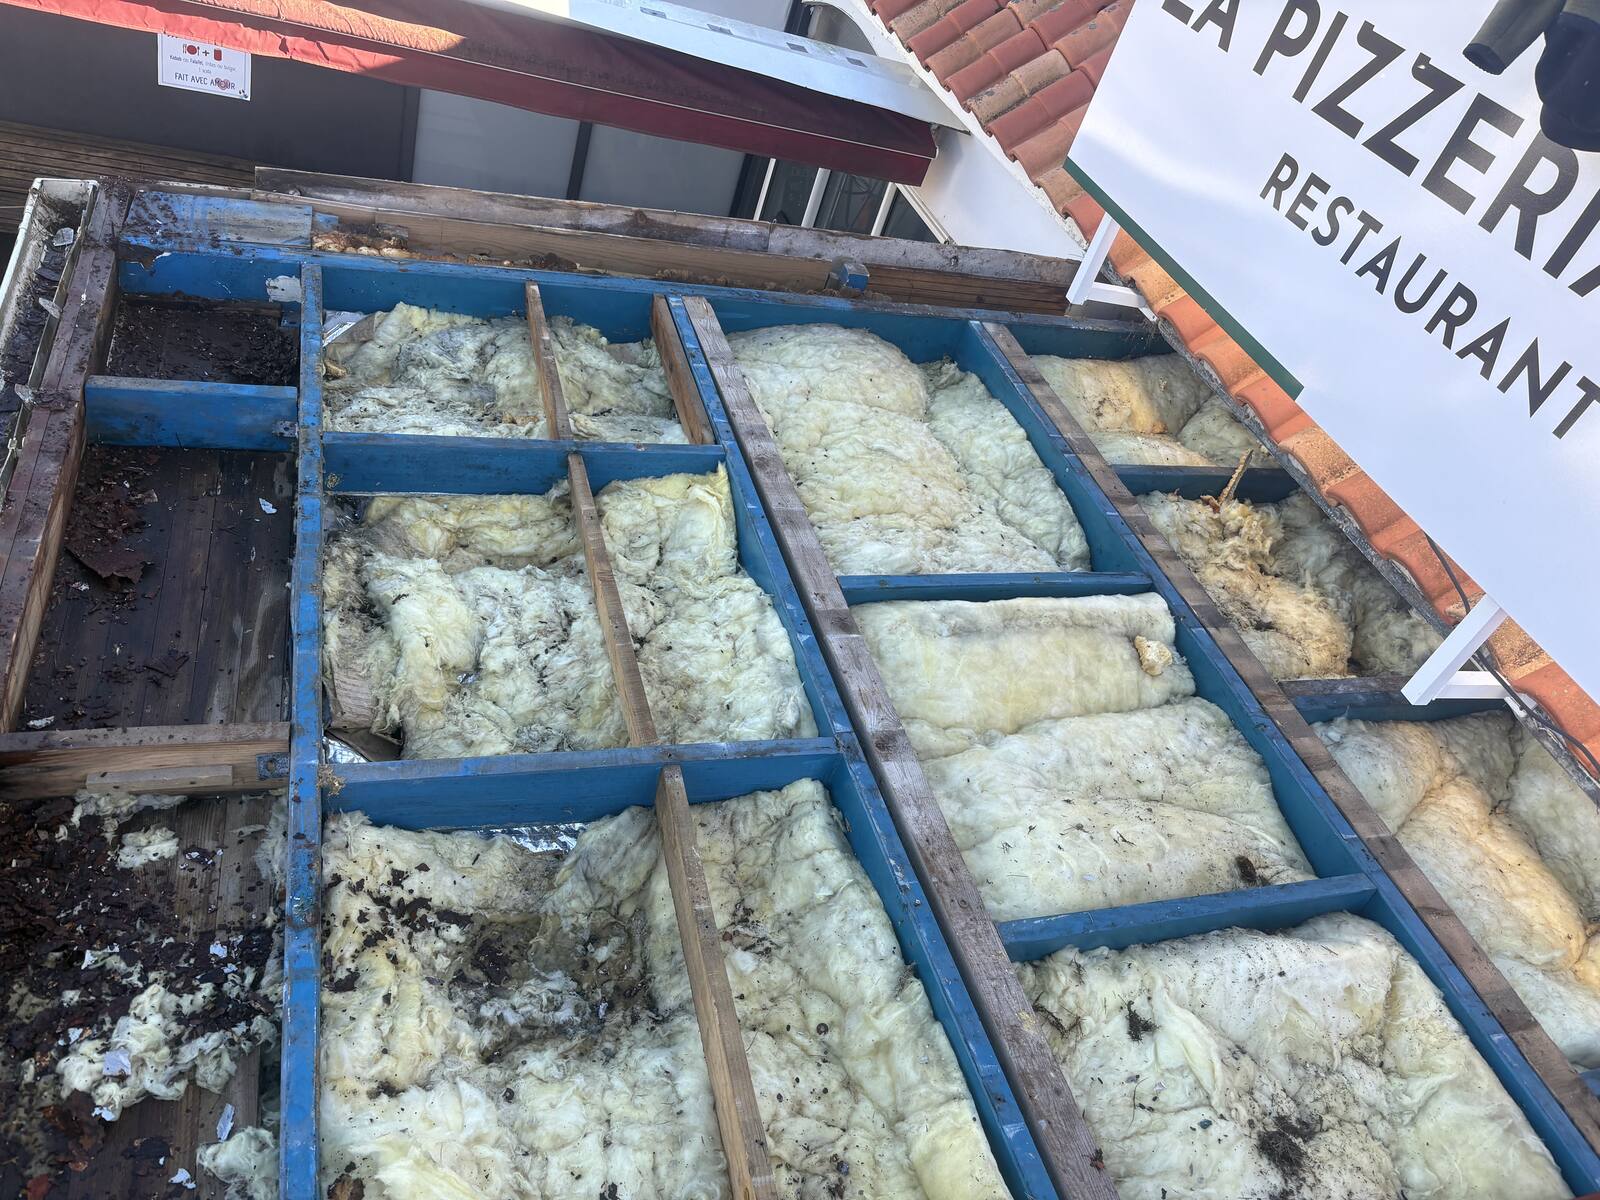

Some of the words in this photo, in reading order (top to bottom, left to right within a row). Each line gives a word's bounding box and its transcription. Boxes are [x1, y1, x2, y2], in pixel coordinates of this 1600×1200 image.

[174, 72, 189, 82] FAIT
[190, 75, 208, 86] AVEC
[209, 78, 236, 90] AMOUR
[1253, 0, 1600, 298] PIZZERI
[1259, 152, 1600, 440] RESTAURANT
